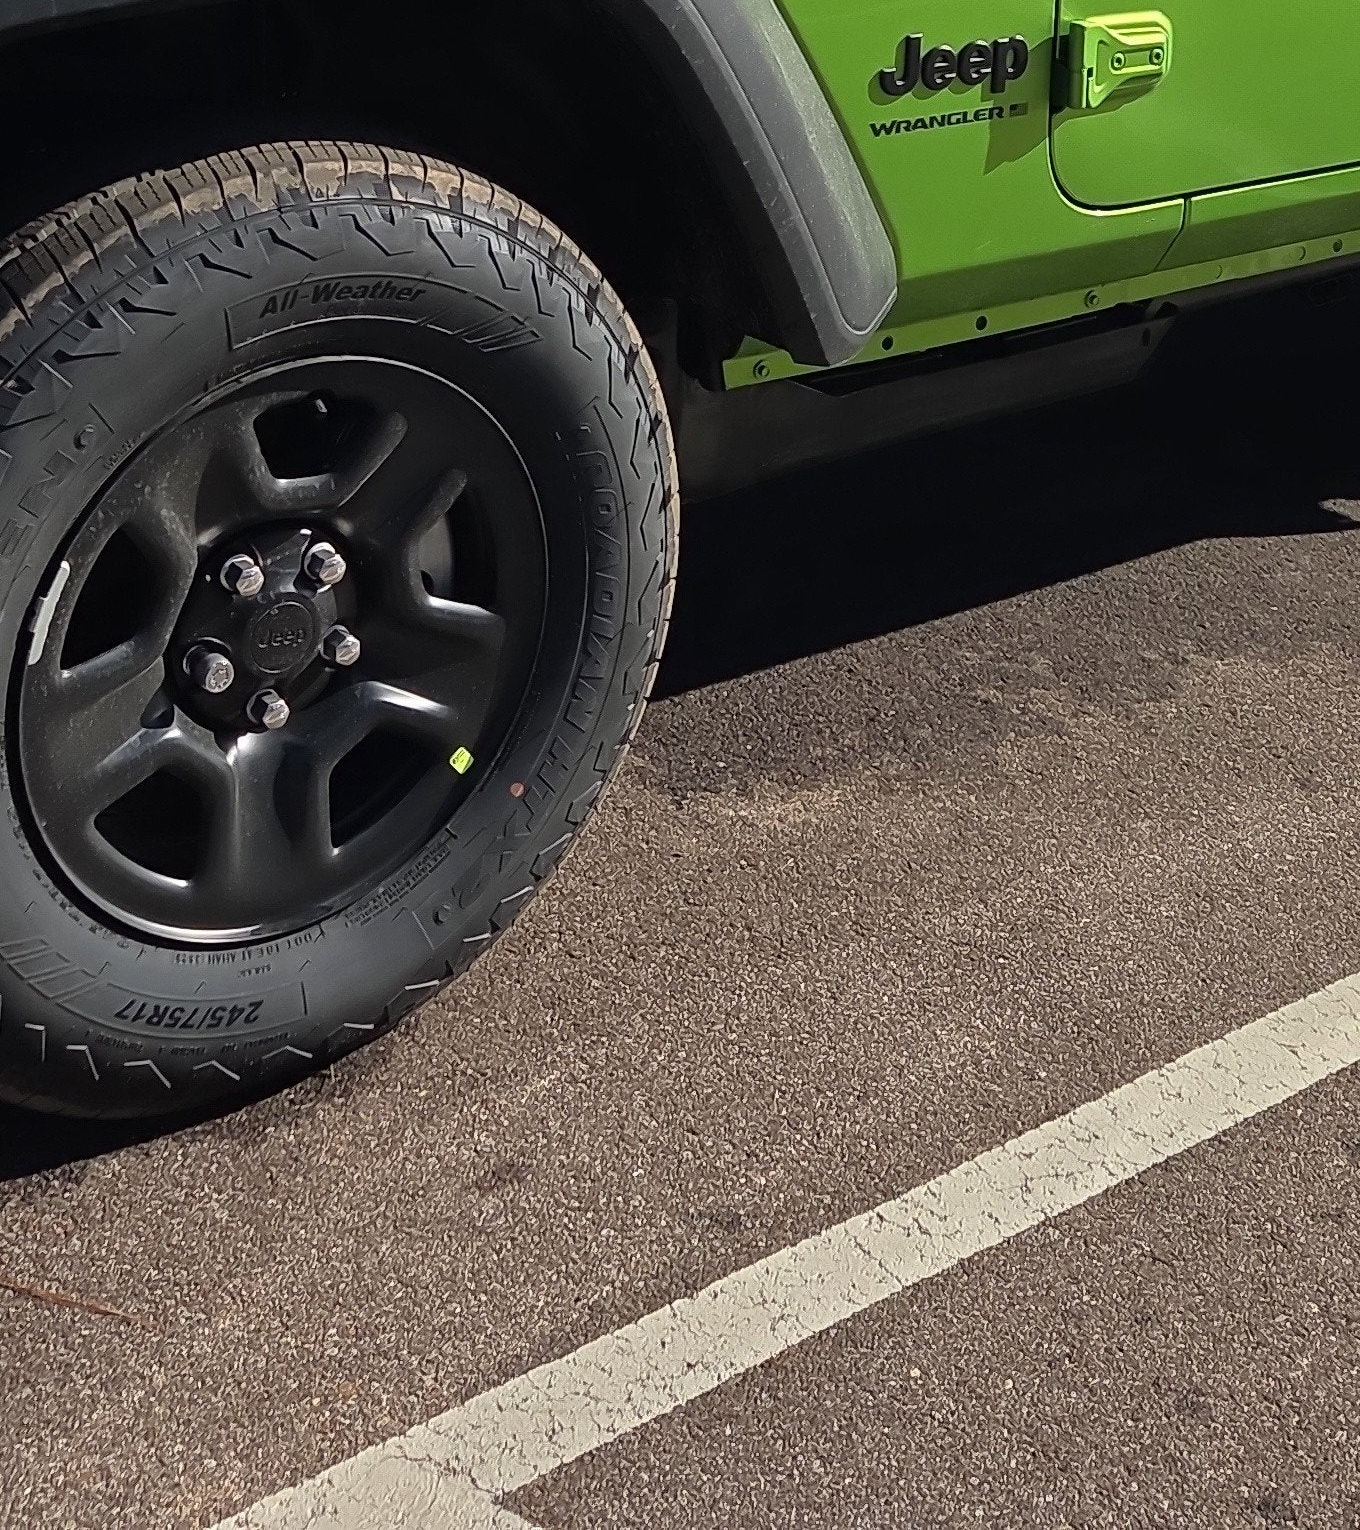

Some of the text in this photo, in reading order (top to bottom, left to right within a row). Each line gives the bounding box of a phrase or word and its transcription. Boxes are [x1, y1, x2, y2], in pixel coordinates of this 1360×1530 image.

[879, 32, 1029, 97] Jeep
[869, 105, 1004, 138] WRANGLER
[259, 281, 427, 320] All-Weather
[257, 627, 306, 650] Jeep
[114, 999, 264, 1030] 245/75R17
